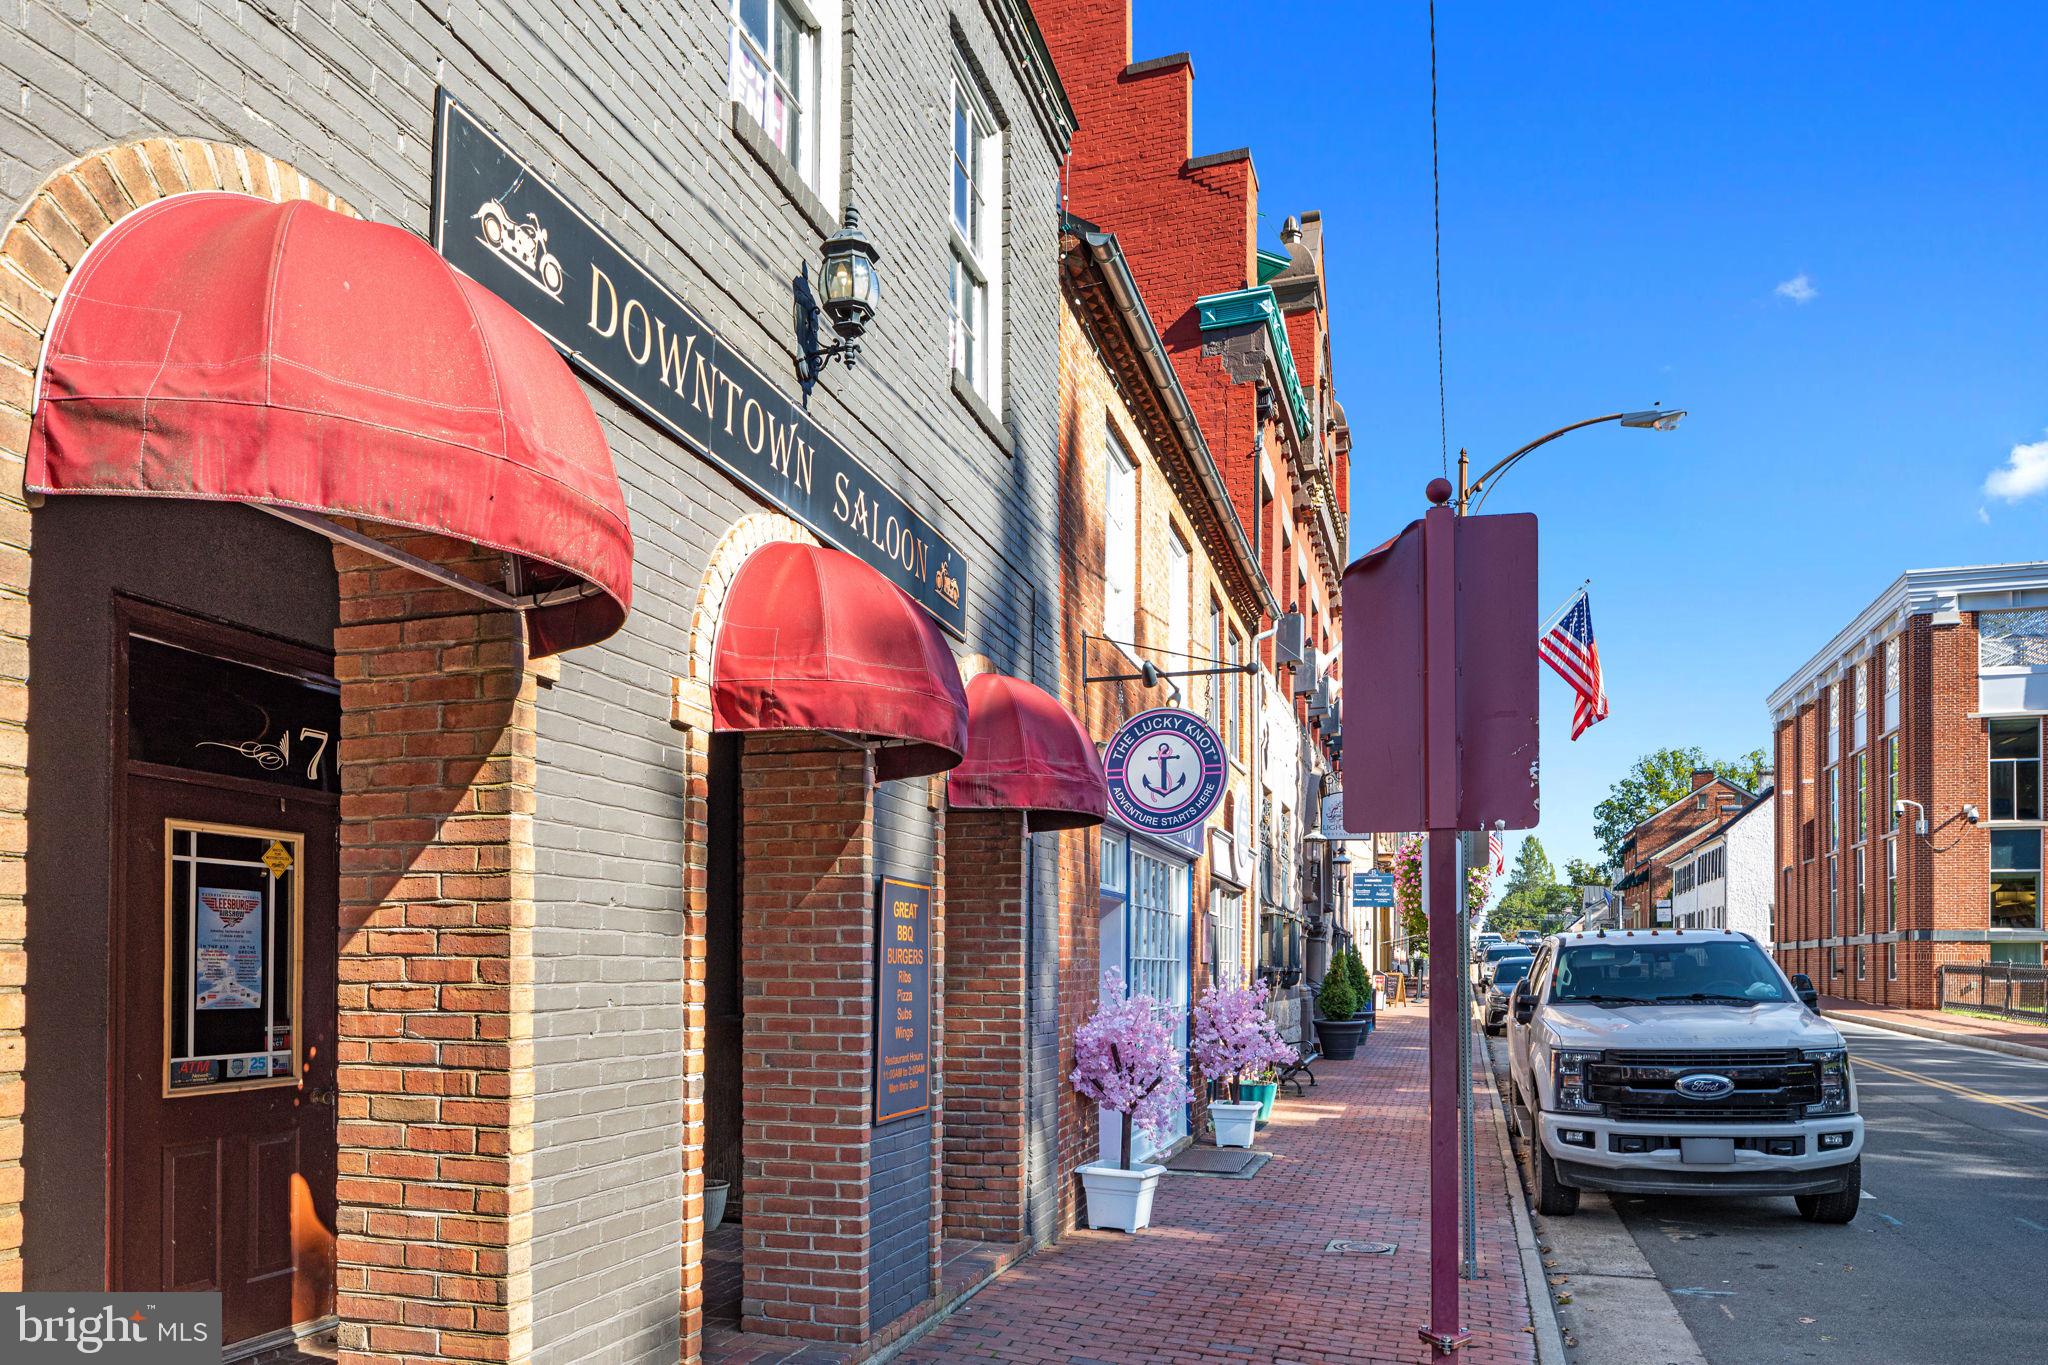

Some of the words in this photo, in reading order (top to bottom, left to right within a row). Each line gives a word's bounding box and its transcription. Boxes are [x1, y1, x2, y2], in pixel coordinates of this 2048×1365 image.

[587, 263, 815, 495] DOWNTOWN
[833, 472, 930, 583] SALOON
[1112, 733, 1135, 760] THE
[1134, 717, 1183, 736] LUCKY
[1184, 723, 1216, 756] KNOT
[1113, 786, 1159, 826] ADVENTURE
[1160, 806, 1197, 827] STARTS
[1195, 782, 1216, 809] HERE
[214, 898, 249, 911] LEESBURG
[893, 901, 919, 919] GREAT
[219, 909, 245, 917] AIRSHOW
[897, 924, 914, 942] BBQ
[887, 947, 924, 965] BURGERS
[898, 969, 912, 984] Ribs
[896, 988, 913, 1002] Pizza
[896, 1007, 913, 1020] Subs
[895, 1026, 914, 1041] Wings
[250, 1056, 267, 1070] 25
[884, 1054, 910, 1065] Restaurant
[909, 1051, 924, 1062] Hours
[179, 1060, 210, 1073] ATM
[1691, 1079, 1719, 1091] Ford
